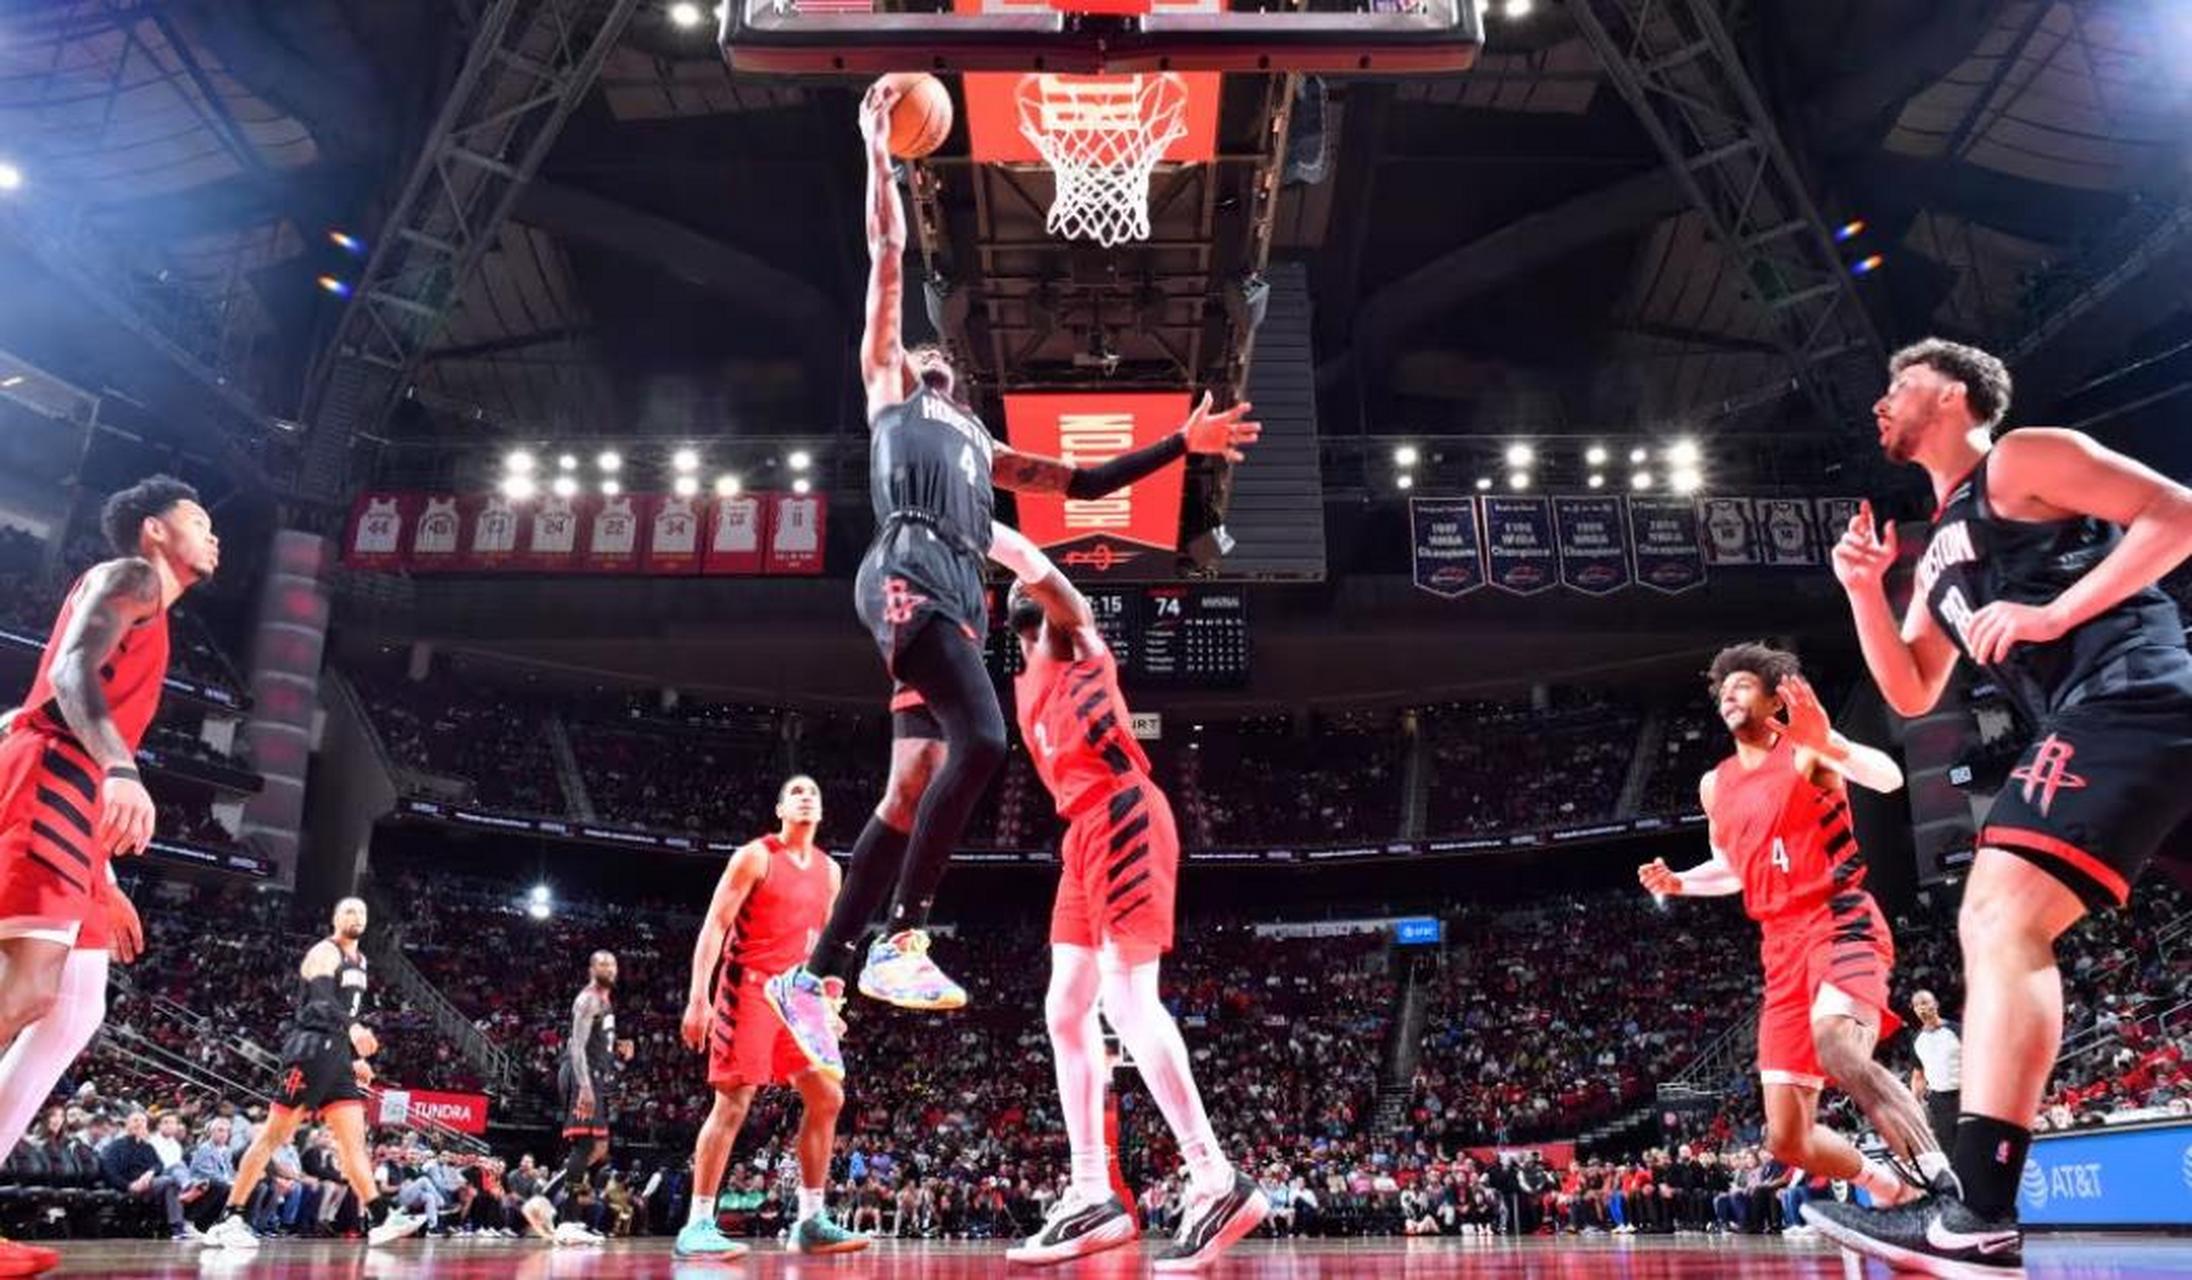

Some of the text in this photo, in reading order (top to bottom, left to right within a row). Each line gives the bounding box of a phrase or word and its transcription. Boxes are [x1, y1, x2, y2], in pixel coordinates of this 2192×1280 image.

[960, 444, 977, 486] 4
[1059, 414, 1134, 528] HOTON
[1155, 597, 1181, 616] 74
[1772, 837, 1790, 873] 4
[414, 1101, 472, 1122] TUNDRA
[2052, 1163, 2102, 1199] AT&T
